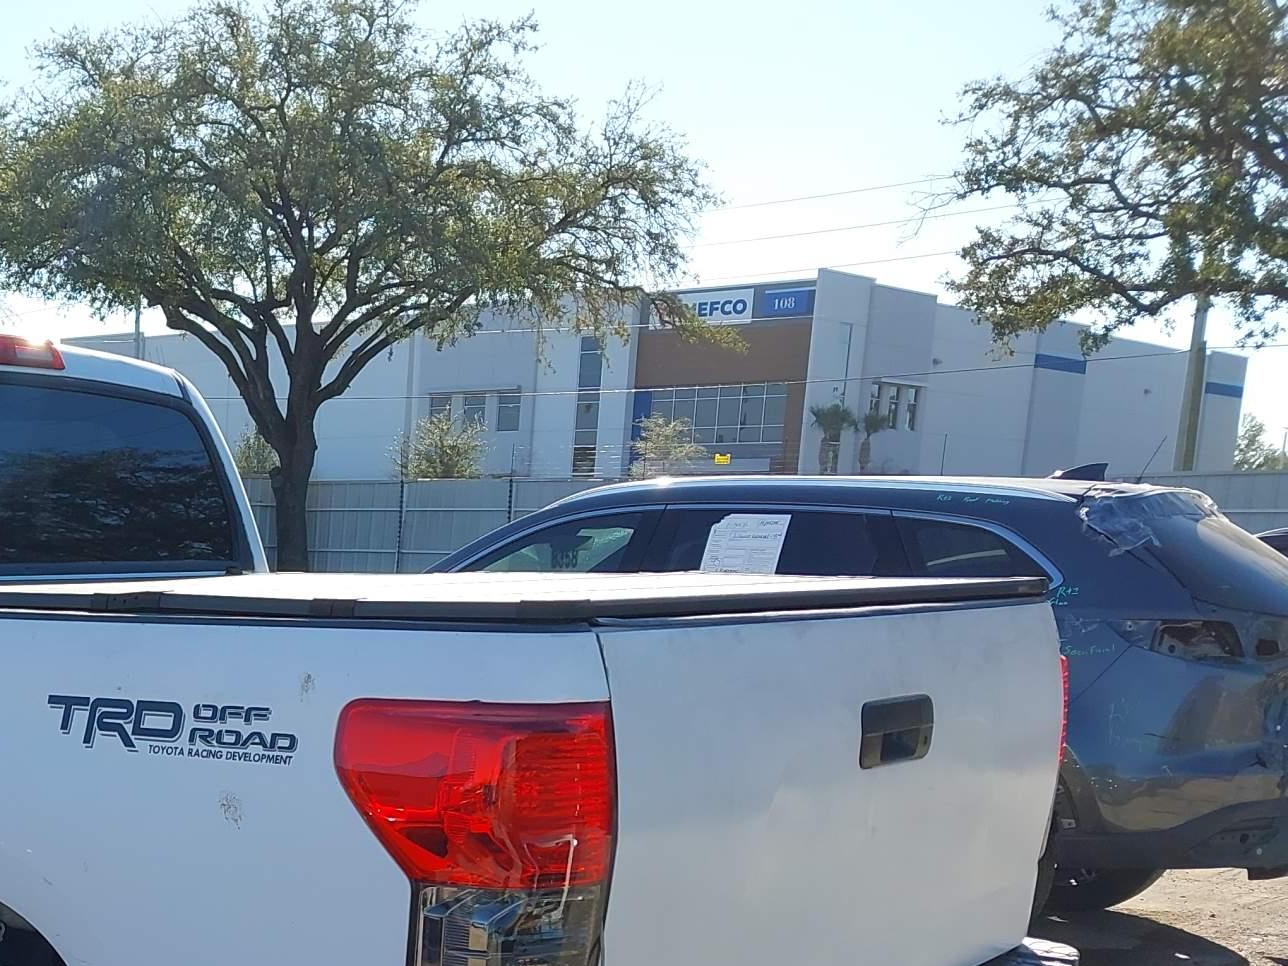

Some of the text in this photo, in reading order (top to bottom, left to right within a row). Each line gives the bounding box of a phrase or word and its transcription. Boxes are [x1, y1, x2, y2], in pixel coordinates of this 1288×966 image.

[686, 299, 748, 317] EFCO
[774, 297, 795, 310] 108
[47, 694, 185, 752] TRD
[193, 703, 272, 725] OFF
[188, 727, 299, 753] ROAD
[148, 744, 294, 766] TOYOTA RACING DEVELOPMENT
